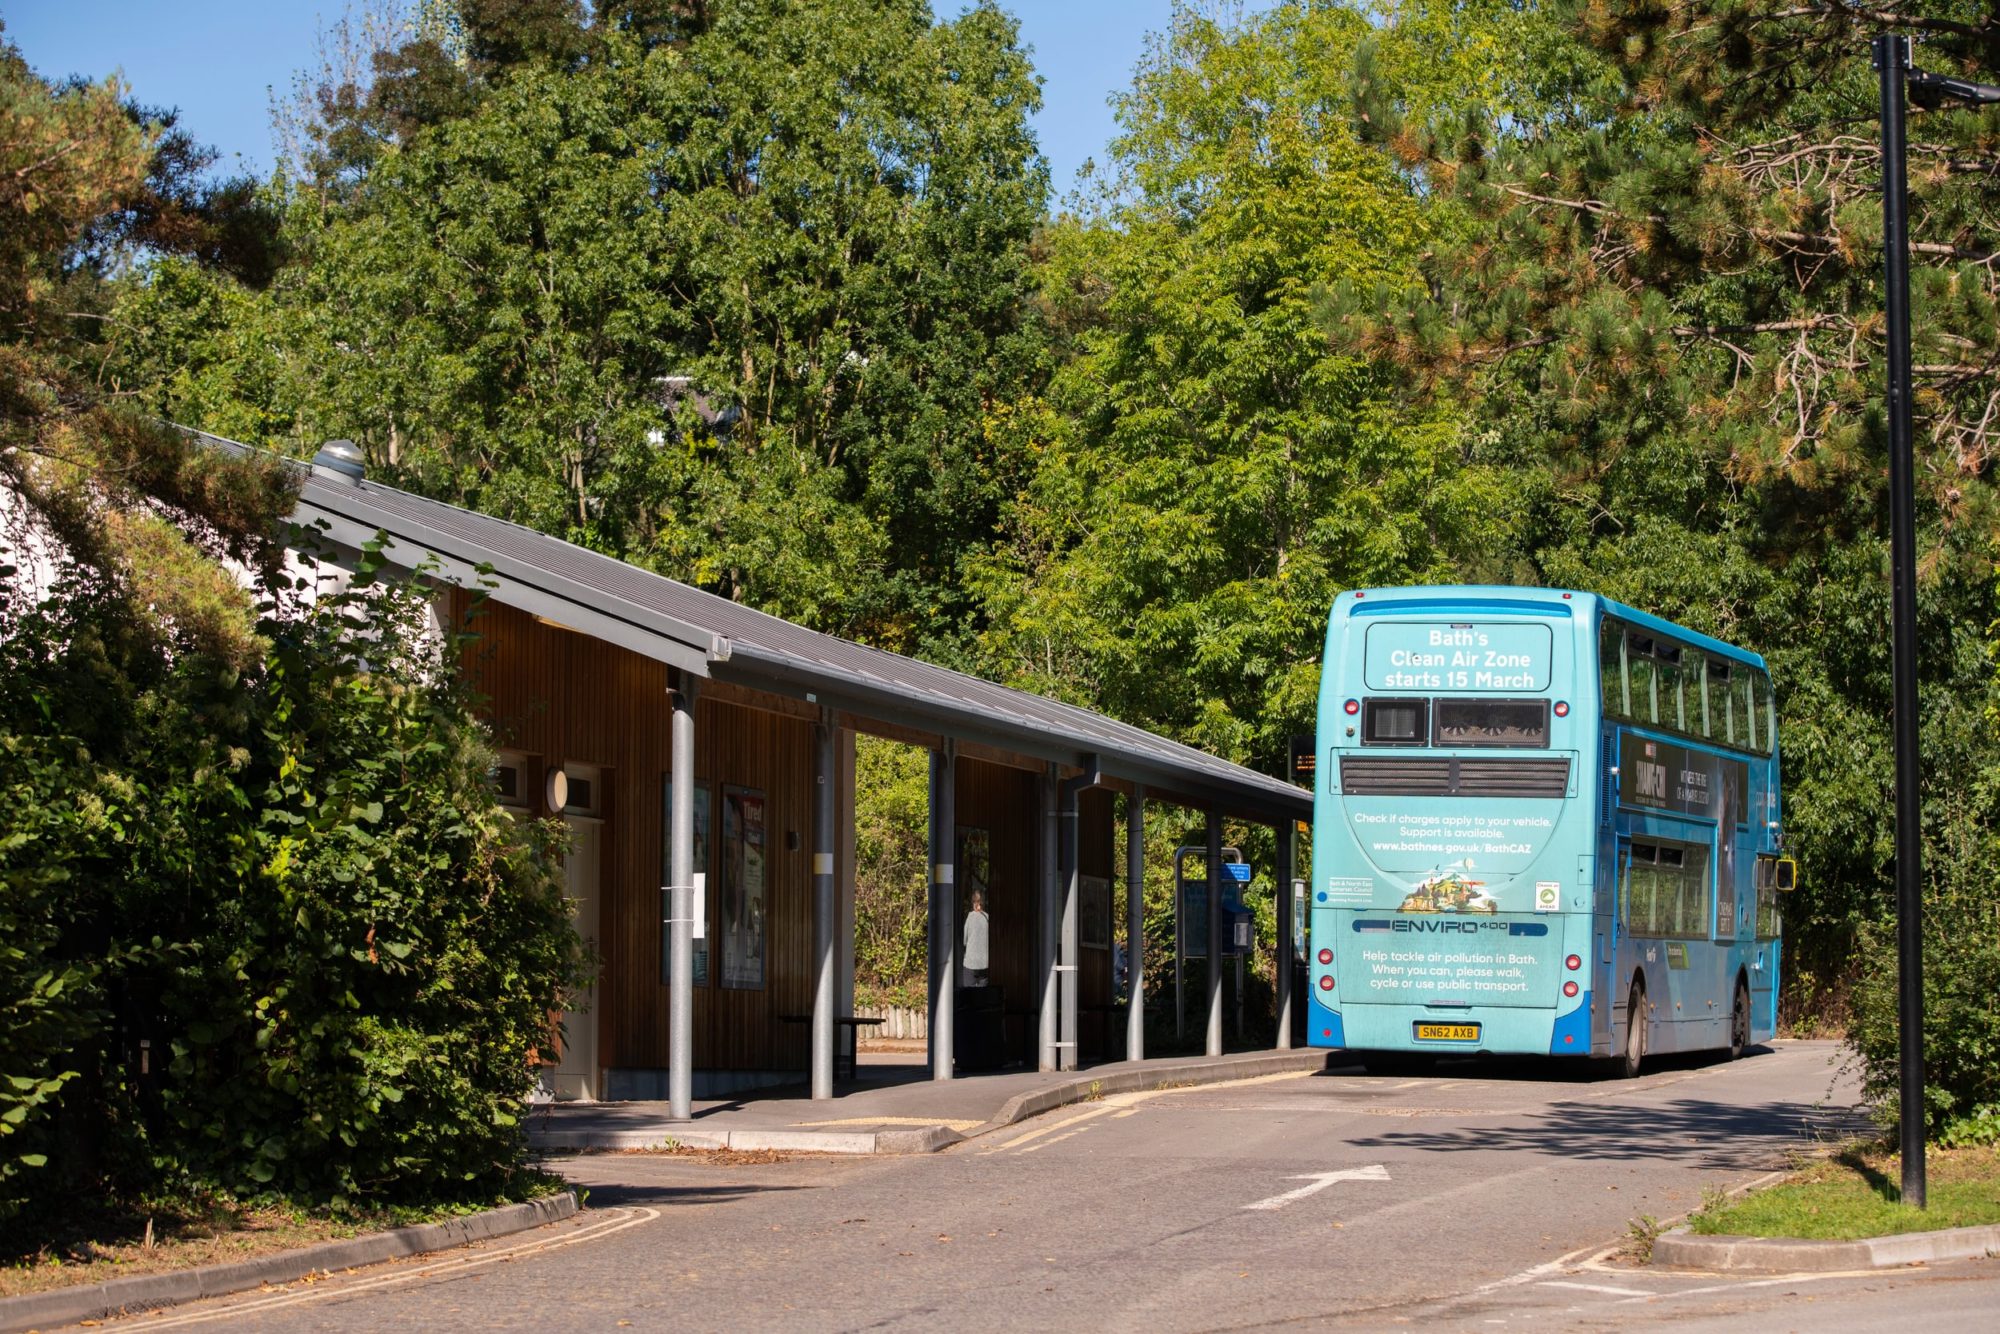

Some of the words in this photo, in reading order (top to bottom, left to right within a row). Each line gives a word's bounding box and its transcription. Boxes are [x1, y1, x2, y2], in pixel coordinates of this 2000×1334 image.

[1429, 629, 1488, 646] Bath's
[1390, 650, 1445, 667] Clean
[1451, 651, 1478, 667] Air
[1484, 651, 1531, 667] Zone
[1385, 671, 1440, 687] starts
[1447, 672, 1468, 687] 15
[1475, 672, 1534, 688] March
[1354, 813, 1387, 823] Check
[1389, 813, 1396, 823] if
[1398, 814, 1439, 826] charges
[1442, 816, 1472, 827] apply
[1474, 816, 1485, 825] to
[1487, 817, 1511, 827] your
[1513, 816, 1552, 827] vehicle.
[1400, 827, 1441, 839] Support
[1444, 828, 1452, 838] is
[1454, 828, 1504, 839] available.
[1373, 841, 1532, 854] www.bathnes.gov.uk/BathCAZ
[1362, 951, 1387, 962] Help
[1390, 951, 1425, 962] tackle
[1427, 952, 1442, 962] air
[1444, 953, 1493, 965] pollution
[1495, 953, 1506, 963] in
[1508, 954, 1538, 965] Bath.
[1371, 964, 1404, 975] When
[1406, 967, 1427, 977] you
[1429, 967, 1453, 977] can,
[1456, 966, 1493, 978] please
[1496, 968, 1525, 979] walk,
[1369, 978, 1399, 989] cycle
[1402, 980, 1413, 988] or
[1415, 981, 1434, 989] use
[1437, 979, 1471, 991] public
[1474, 980, 1529, 992] transport.
[1423, 1027, 1450, 1037] SN62
[1453, 1027, 1473, 1038] AXB
